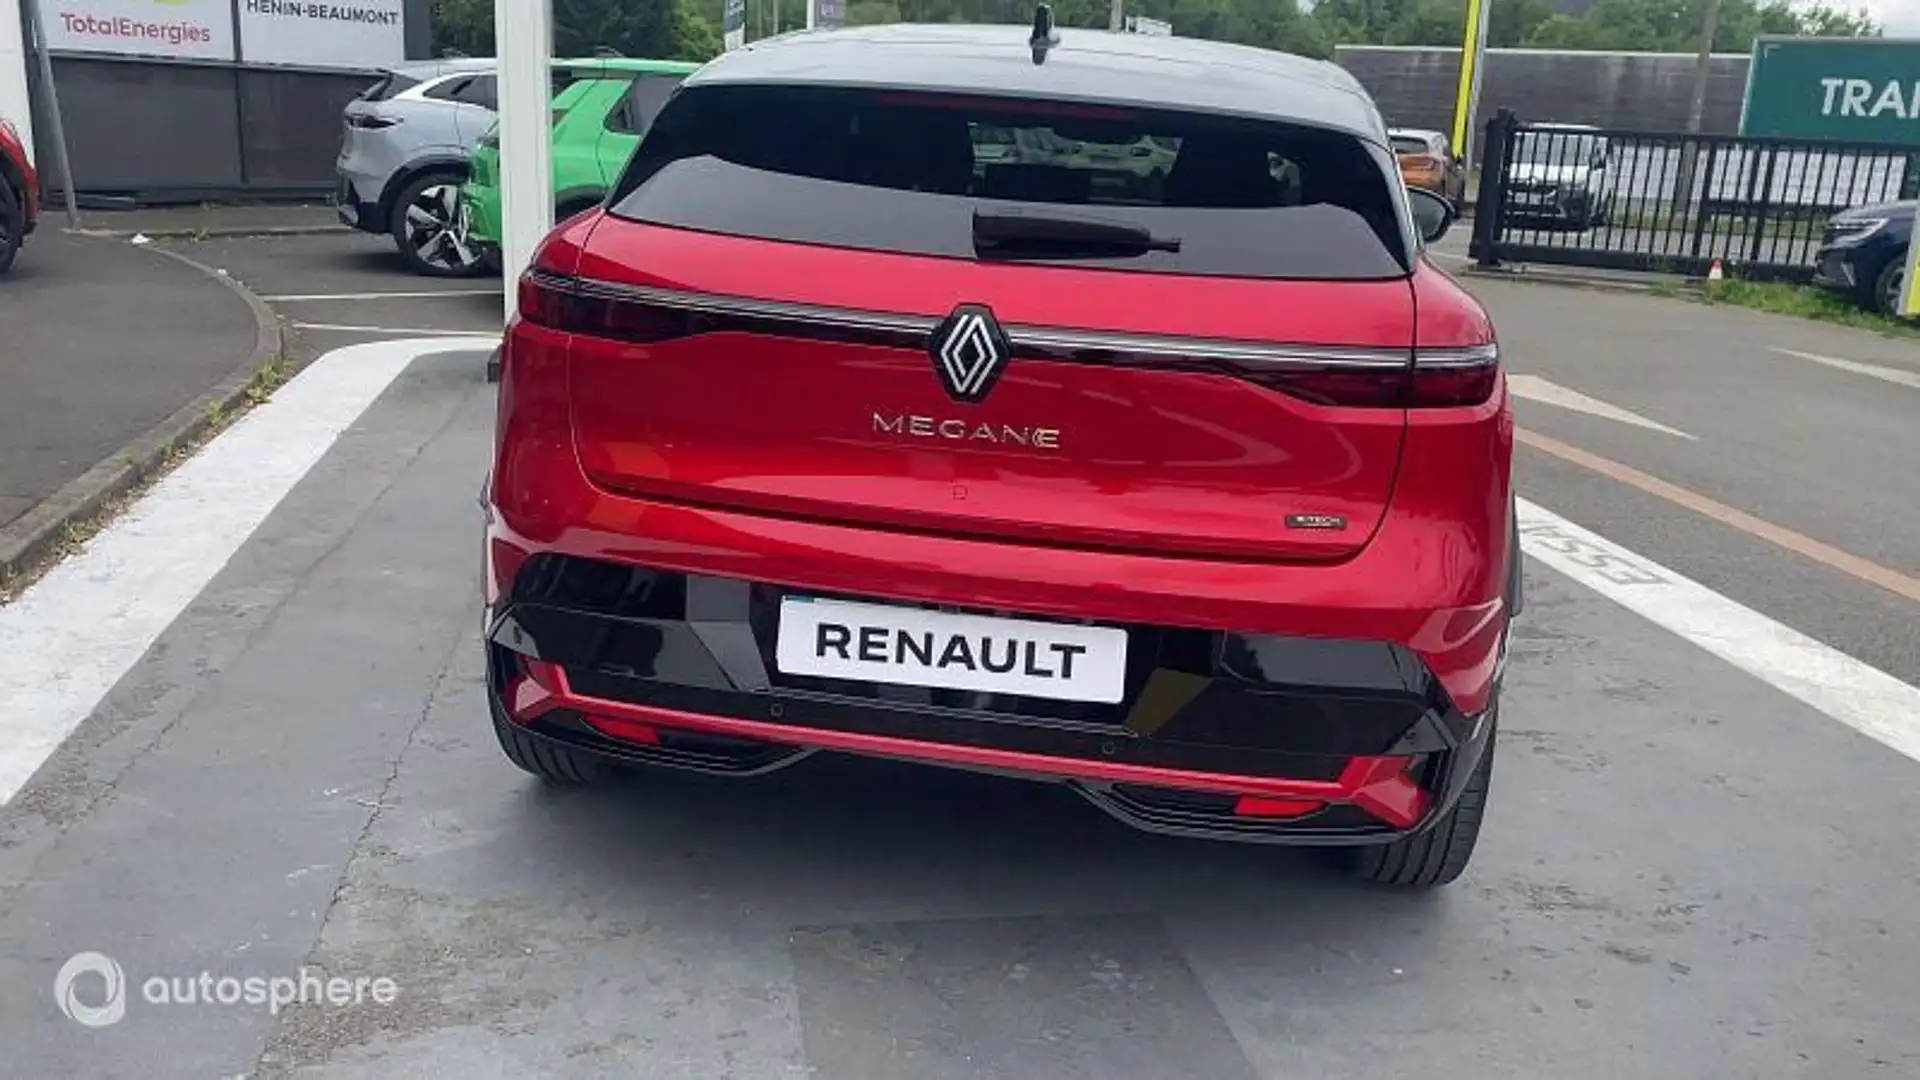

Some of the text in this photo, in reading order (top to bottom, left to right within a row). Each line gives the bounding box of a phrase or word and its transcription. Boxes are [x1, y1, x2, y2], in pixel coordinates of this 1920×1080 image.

[60, 12, 210, 44] TotalEnergies
[872, 411, 1060, 448] MEGANE
[815, 622, 1087, 679] RENAULT
